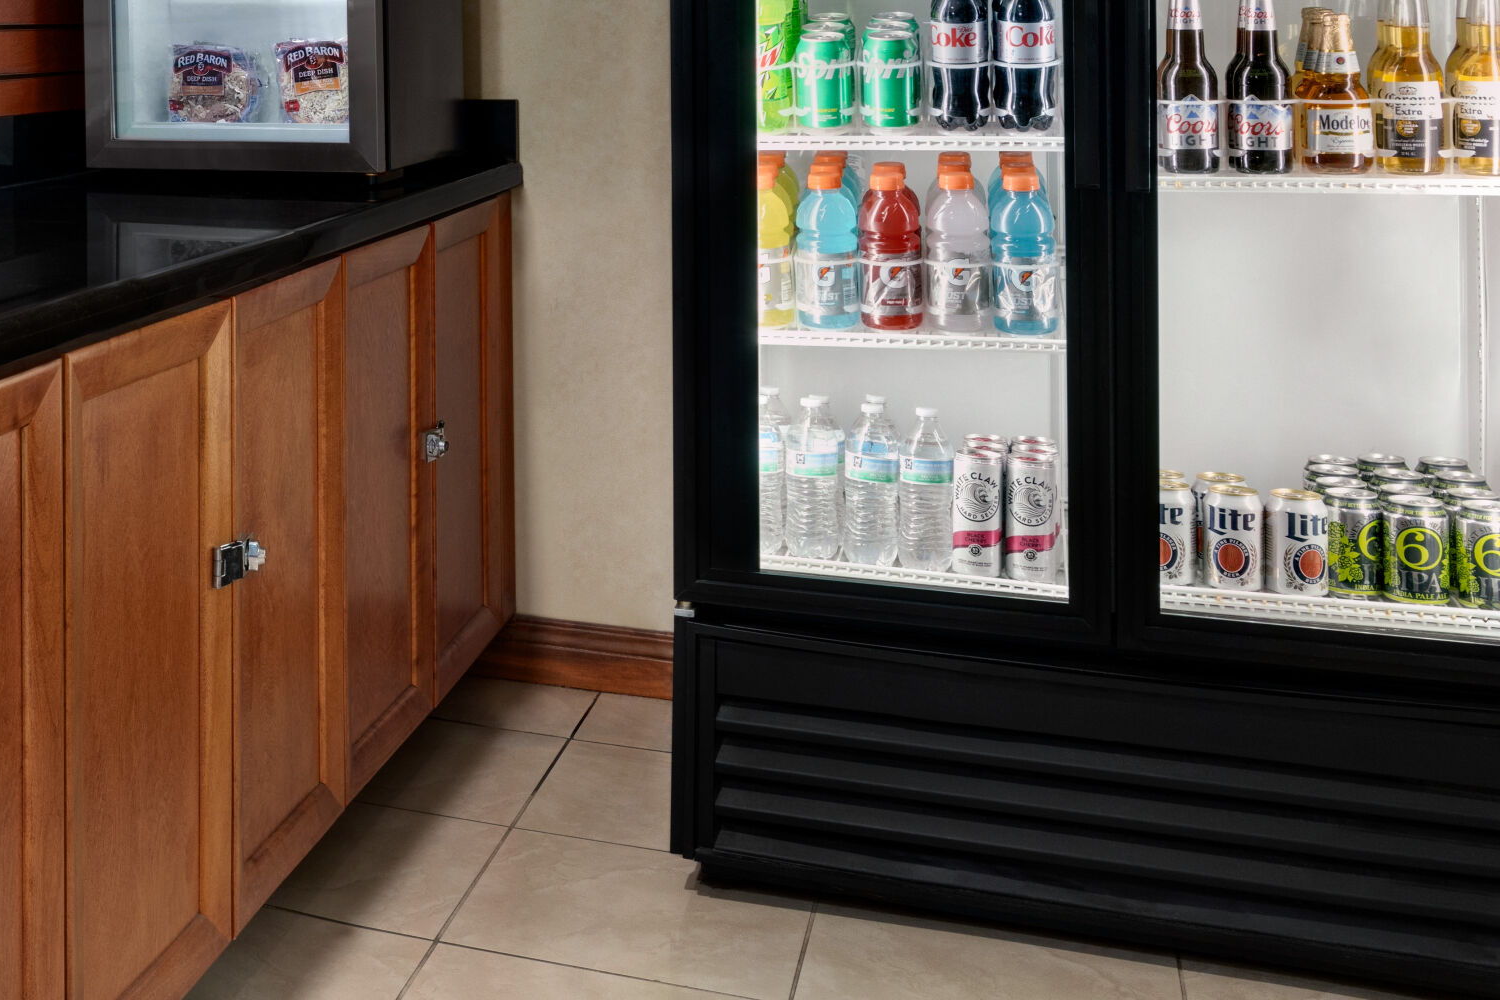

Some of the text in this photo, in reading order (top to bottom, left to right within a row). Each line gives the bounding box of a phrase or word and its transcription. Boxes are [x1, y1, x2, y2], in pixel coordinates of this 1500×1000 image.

[931, 24, 978, 48] Coke
[177, 52, 228, 69] RED BARON
[287, 45, 340, 65] RED BARON
[186, 75, 201, 83] DEEP
[298, 68, 334, 79] DEEP DISH
[1395, 106, 1423, 116] Extra
[1461, 105, 1484, 115] Extra
[1166, 113, 1218, 135] Coors
[1234, 113, 1285, 137] Coors
[970, 472, 998, 489] CLAW
[1008, 476, 1052, 506] WHITE CLAW
[1208, 504, 1256, 536] Lite
[1285, 511, 1328, 543] Lite
[1396, 527, 1443, 571] 6
[1400, 569, 1443, 593] IPA
